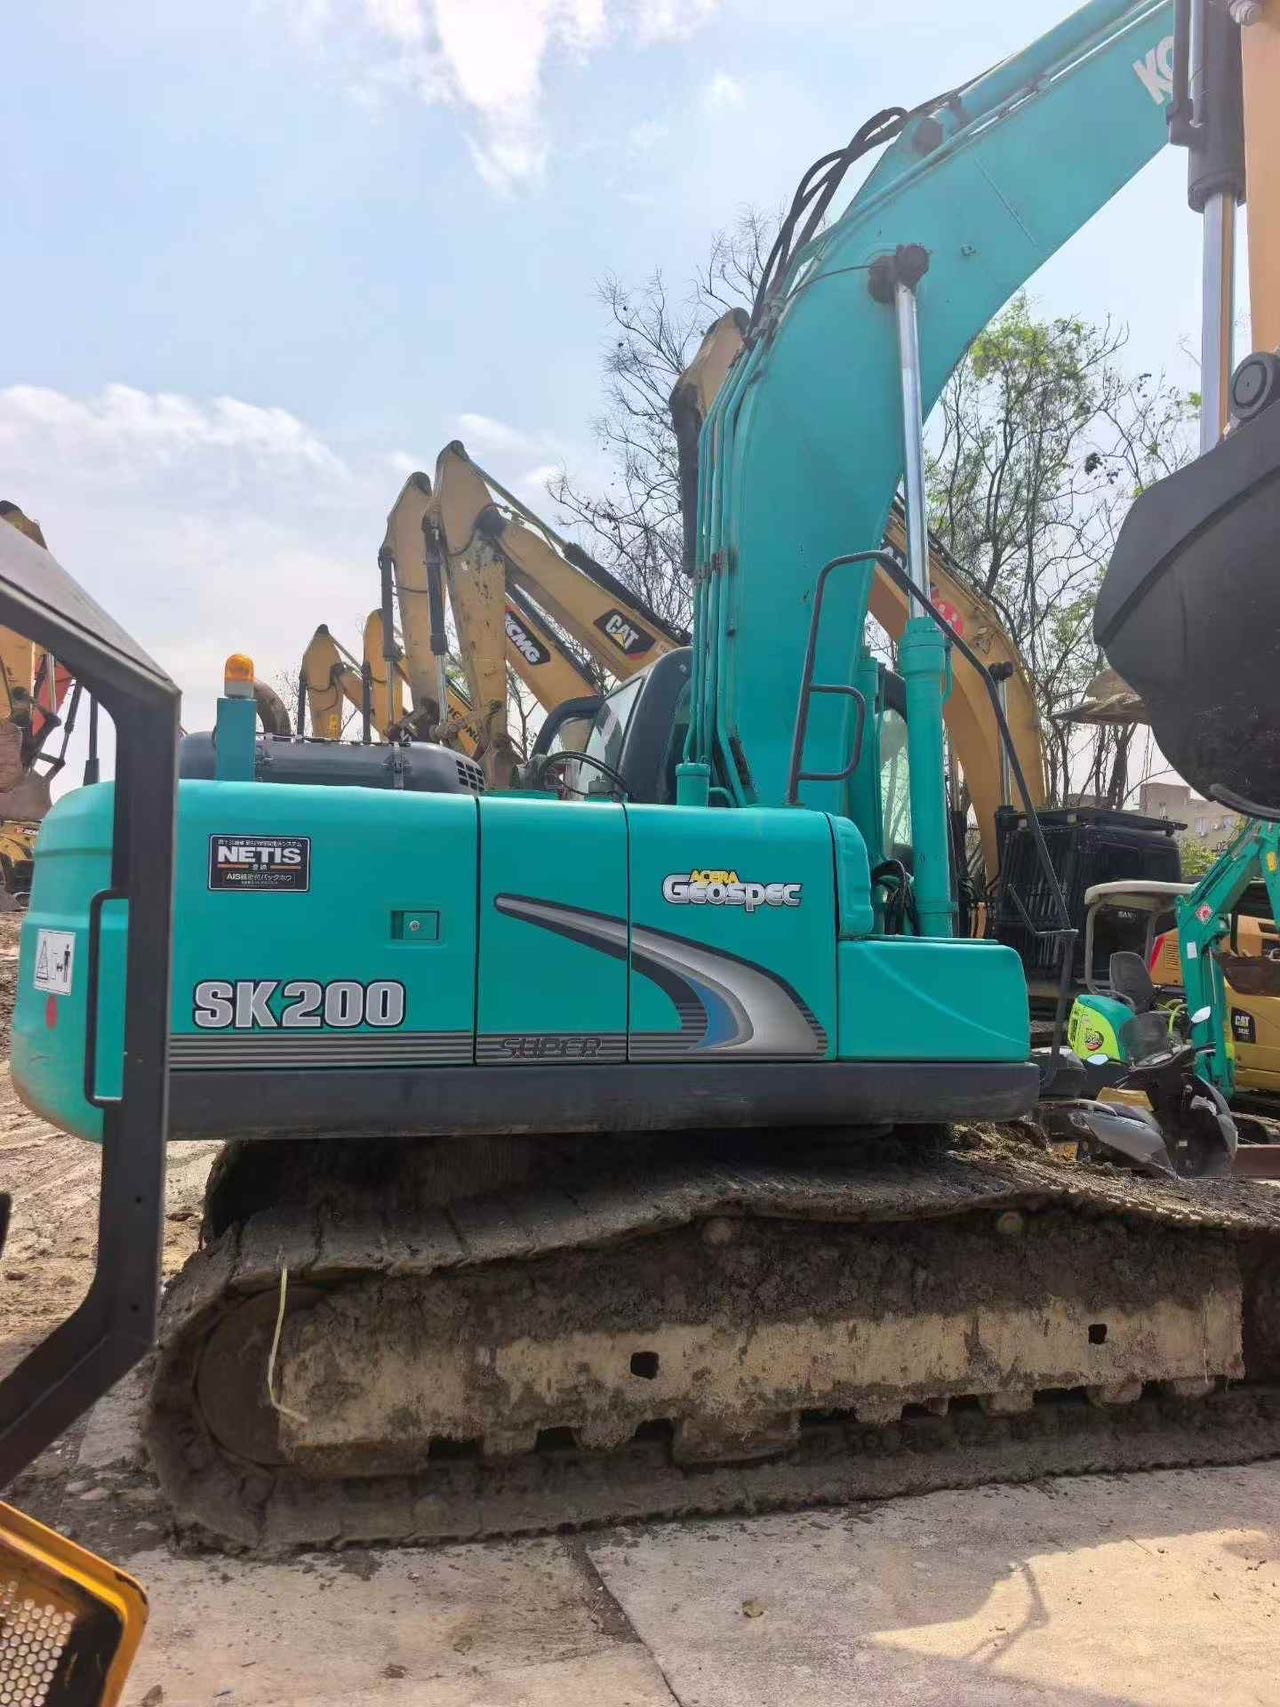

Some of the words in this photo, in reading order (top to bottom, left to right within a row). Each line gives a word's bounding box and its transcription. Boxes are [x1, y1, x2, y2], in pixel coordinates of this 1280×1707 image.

[605, 614, 640, 650] CAT
[217, 845, 302, 864] NETIS
[194, 980, 405, 1028] SK200
[502, 1036, 603, 1059] SUPER
